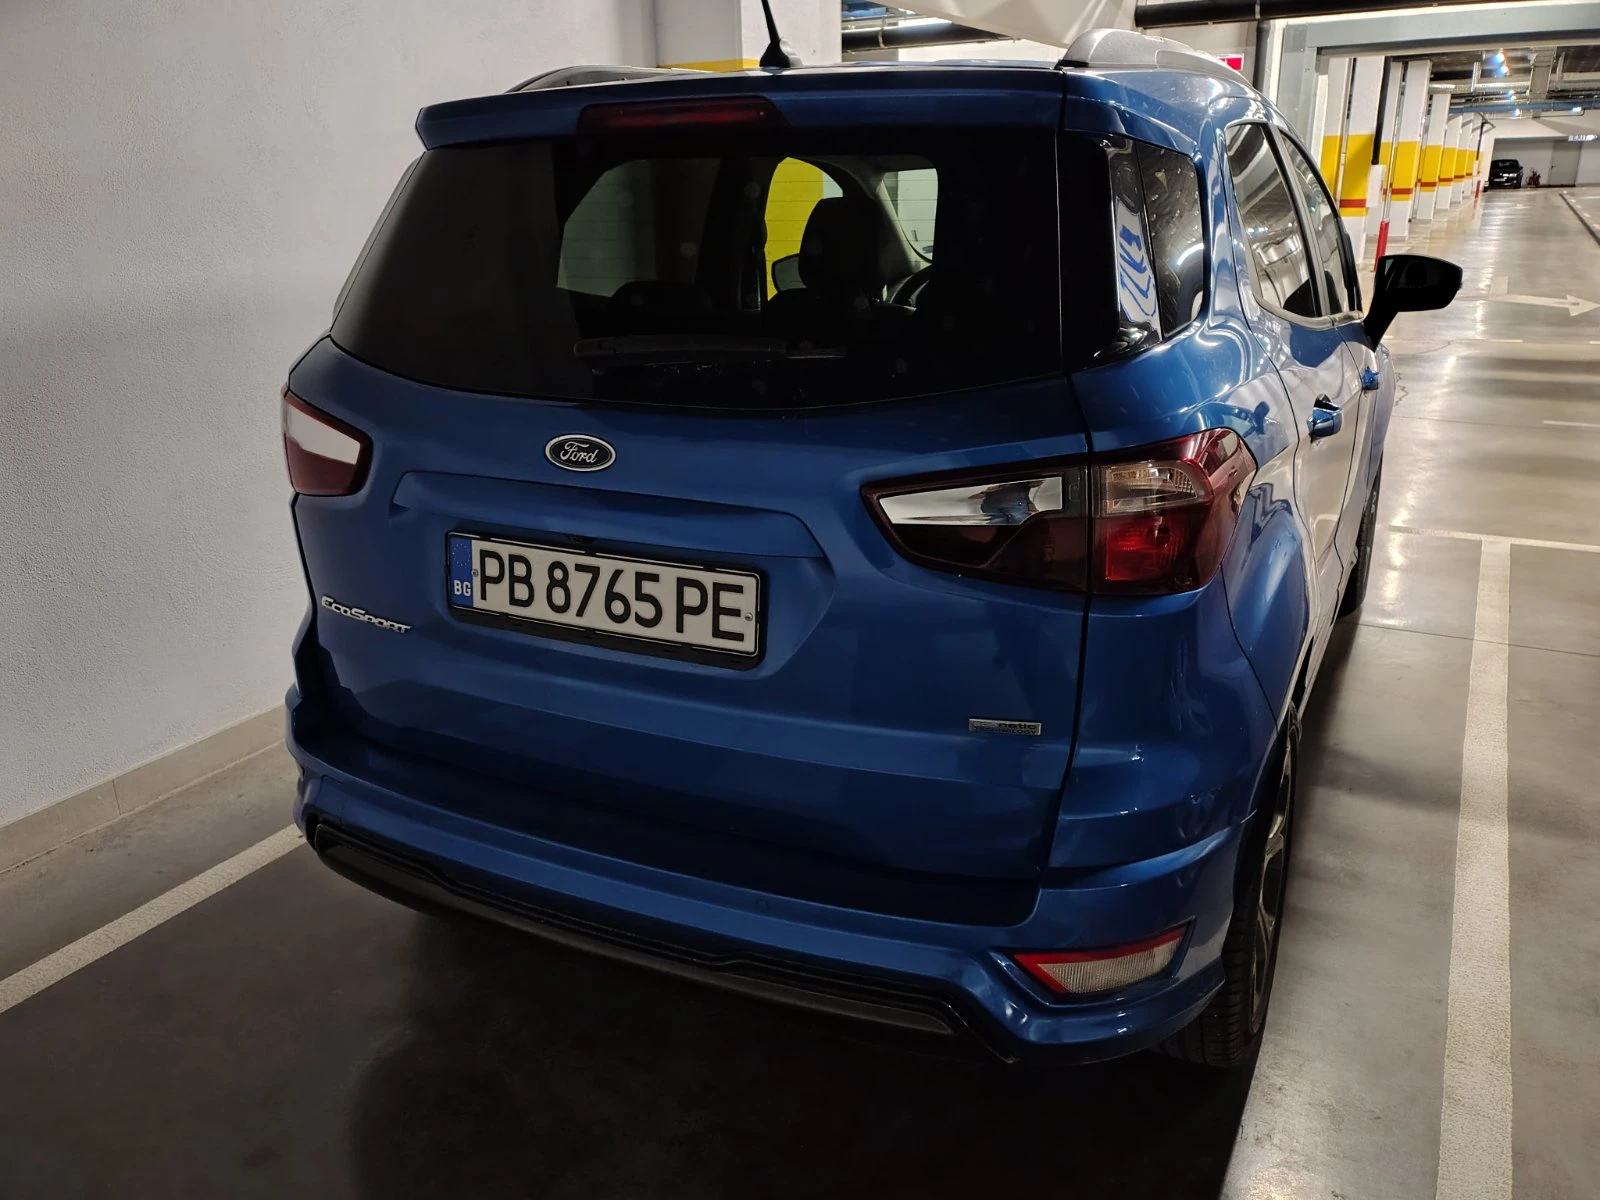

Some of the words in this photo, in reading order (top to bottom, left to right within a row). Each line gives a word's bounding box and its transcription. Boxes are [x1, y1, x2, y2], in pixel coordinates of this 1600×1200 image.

[560, 441, 599, 463] Ford
[453, 579, 472, 597] BG
[479, 549, 535, 608] PB
[546, 561, 663, 628] 8765
[675, 576, 744, 642] PE
